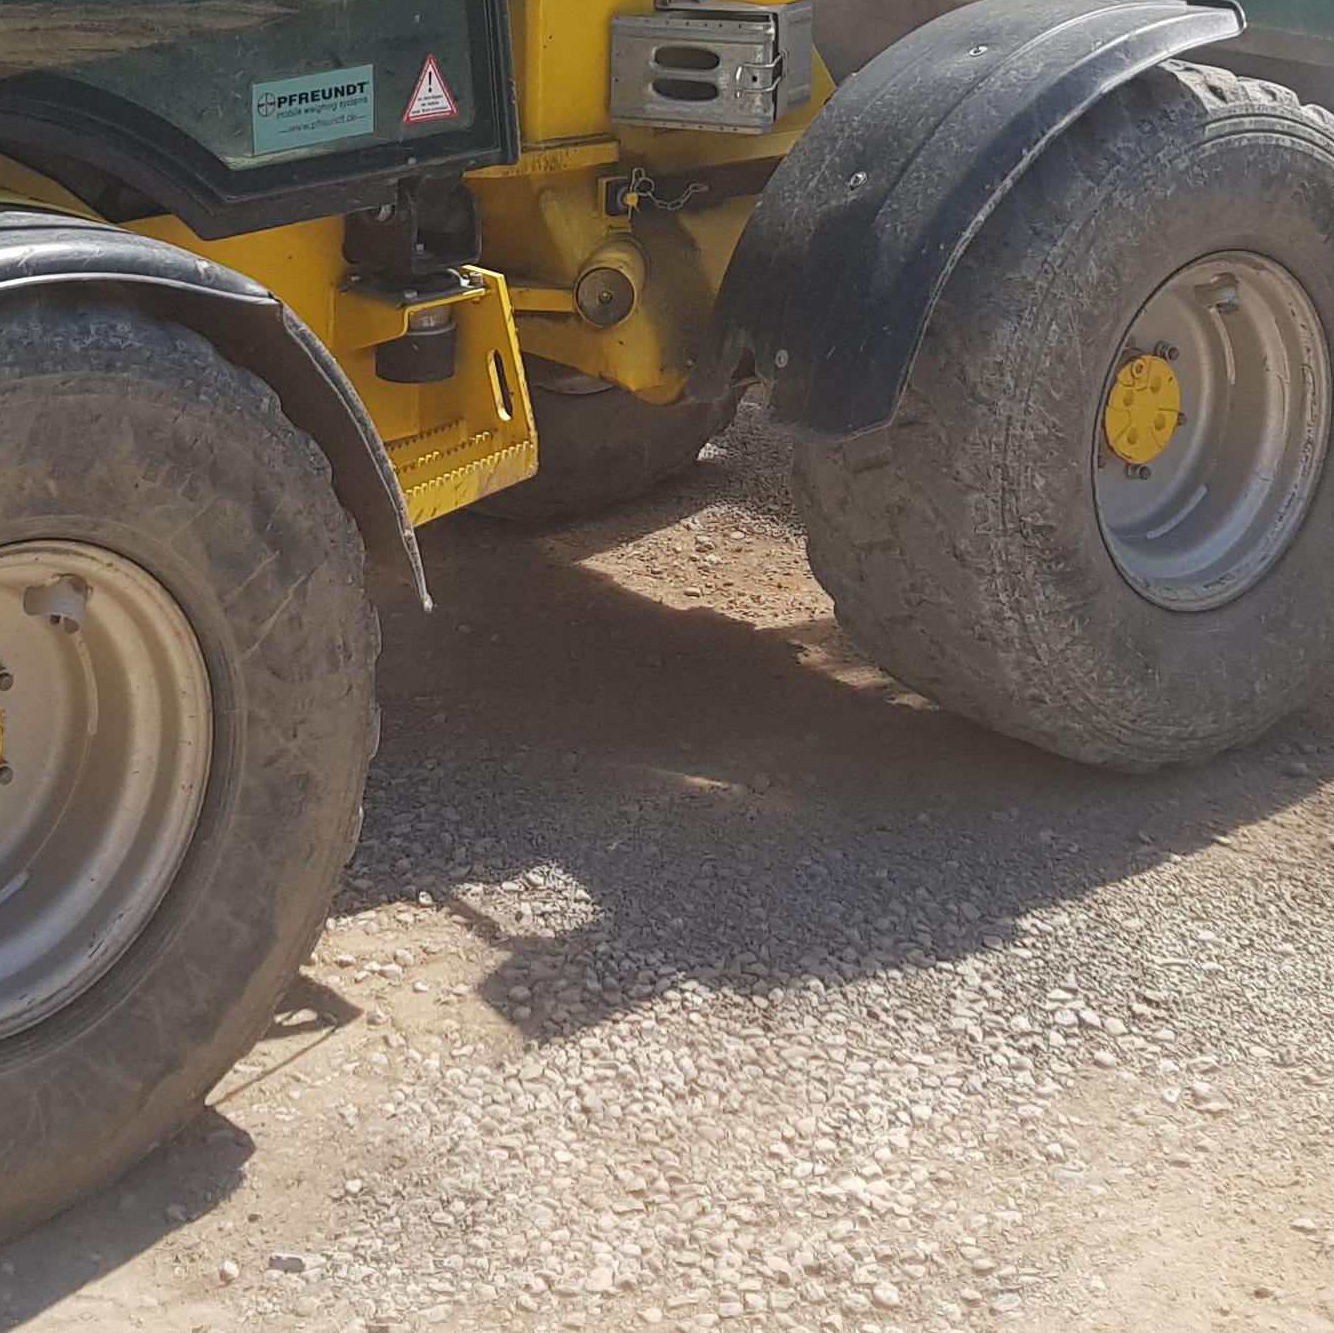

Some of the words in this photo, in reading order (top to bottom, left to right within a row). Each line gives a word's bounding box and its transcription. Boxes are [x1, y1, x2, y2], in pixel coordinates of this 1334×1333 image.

[277, 81, 368, 108] PFREUNDT
[276, 107, 302, 119] mobile
[304, 101, 337, 114] weighing
